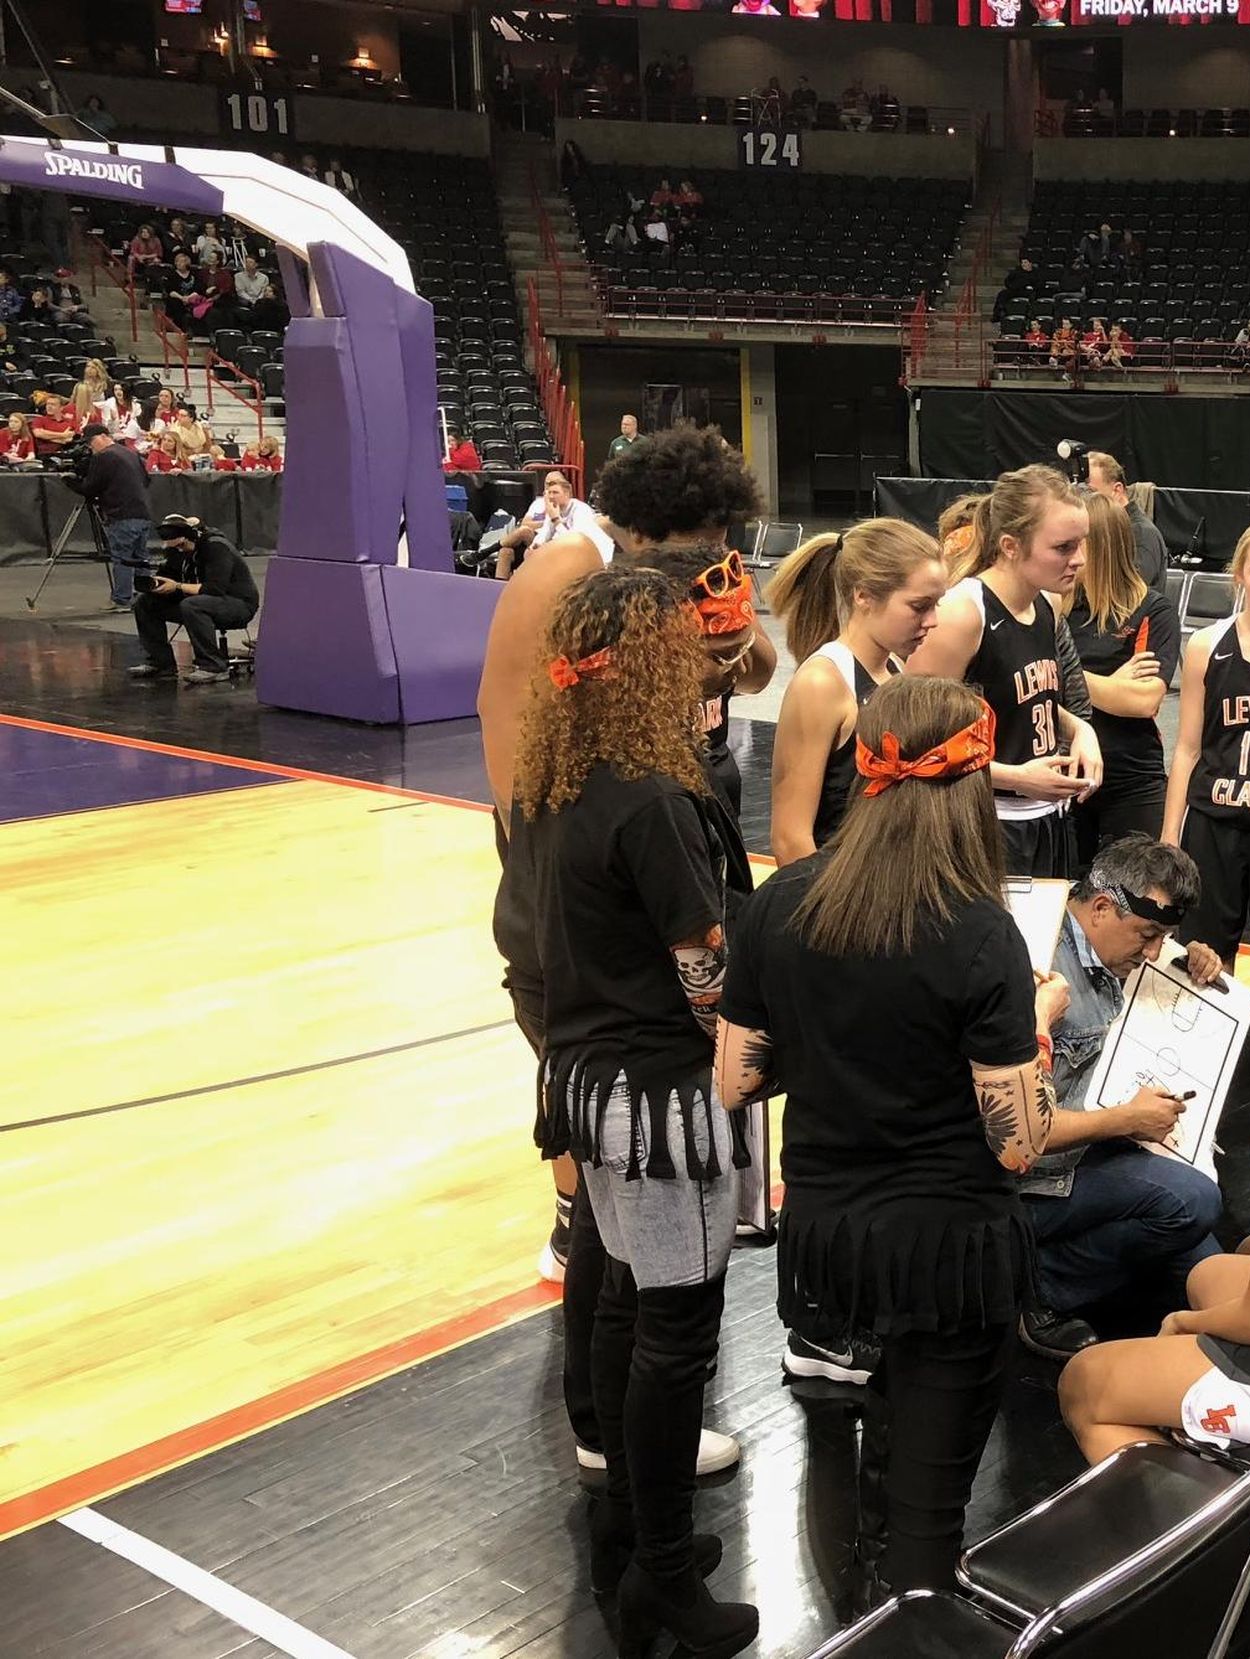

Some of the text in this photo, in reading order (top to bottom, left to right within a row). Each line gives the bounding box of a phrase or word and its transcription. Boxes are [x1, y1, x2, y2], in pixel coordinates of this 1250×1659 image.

[1080, 0, 1239, 17] FRIDAY, MARCH 9
[227, 94, 288, 134] 101
[742, 132, 800, 167] 124
[44, 151, 144, 189] SPALDING
[1013, 658, 1059, 705] LEWIS
